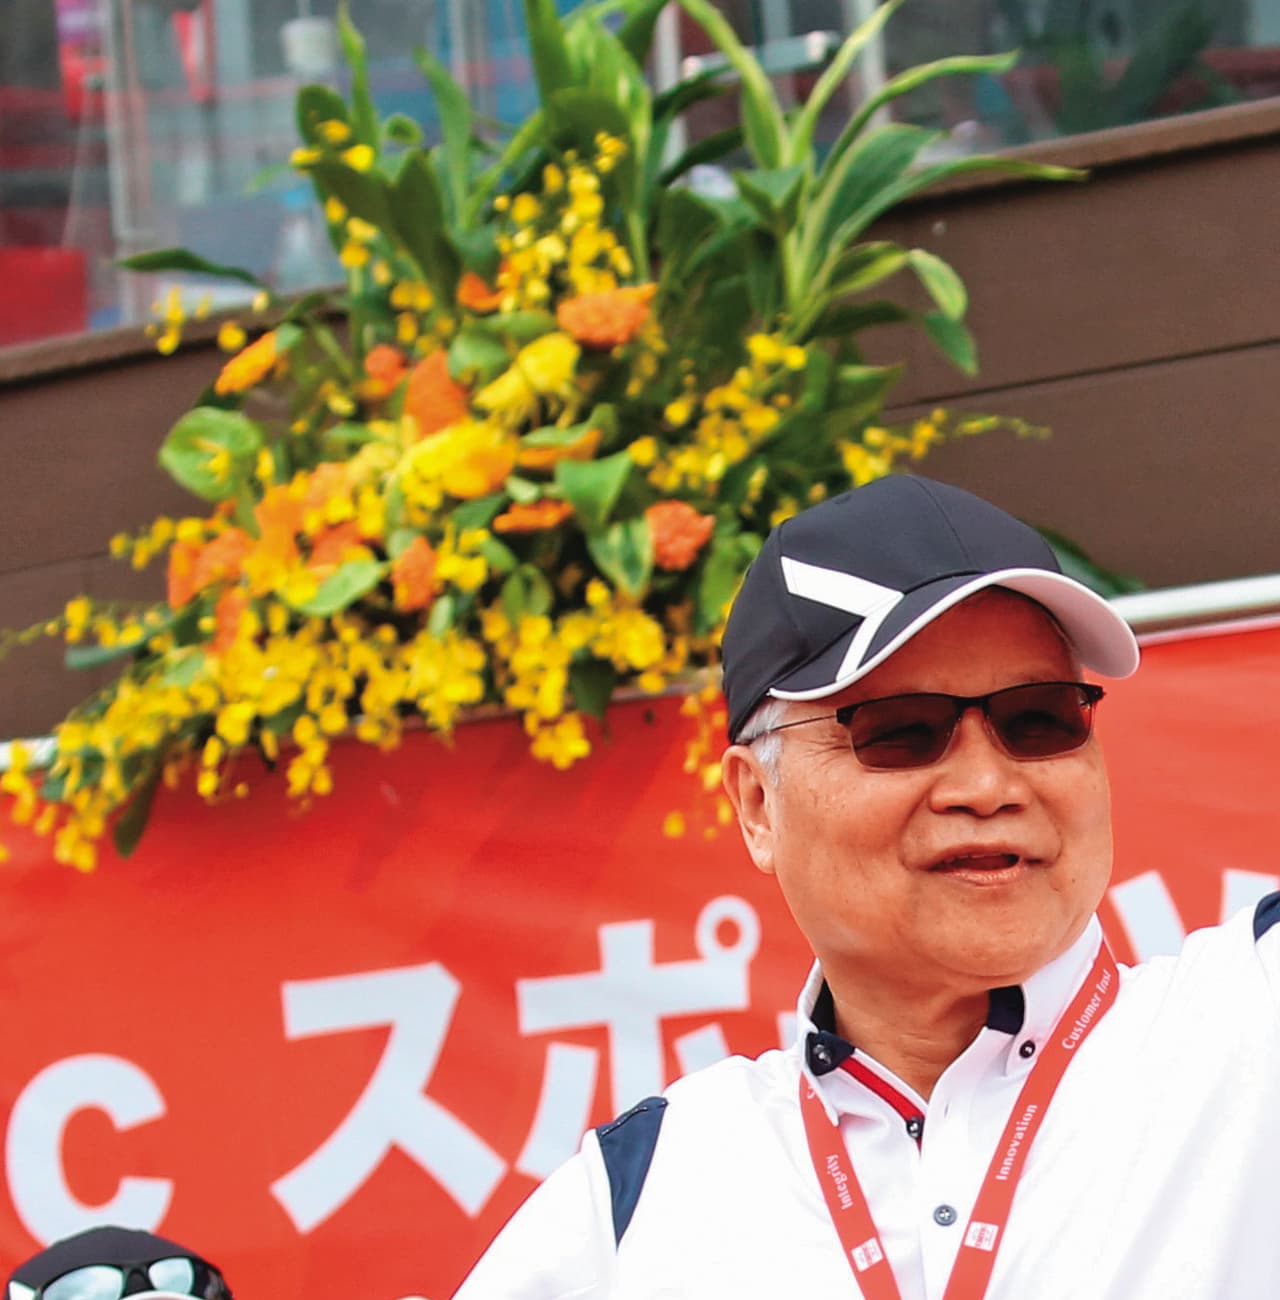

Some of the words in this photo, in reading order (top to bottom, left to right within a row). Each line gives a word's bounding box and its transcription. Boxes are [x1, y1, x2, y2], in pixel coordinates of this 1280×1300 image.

[1061, 992, 1102, 1050] Customer
[995, 1104, 1038, 1180] Innovation
[826, 1154, 854, 1210] Integrity
